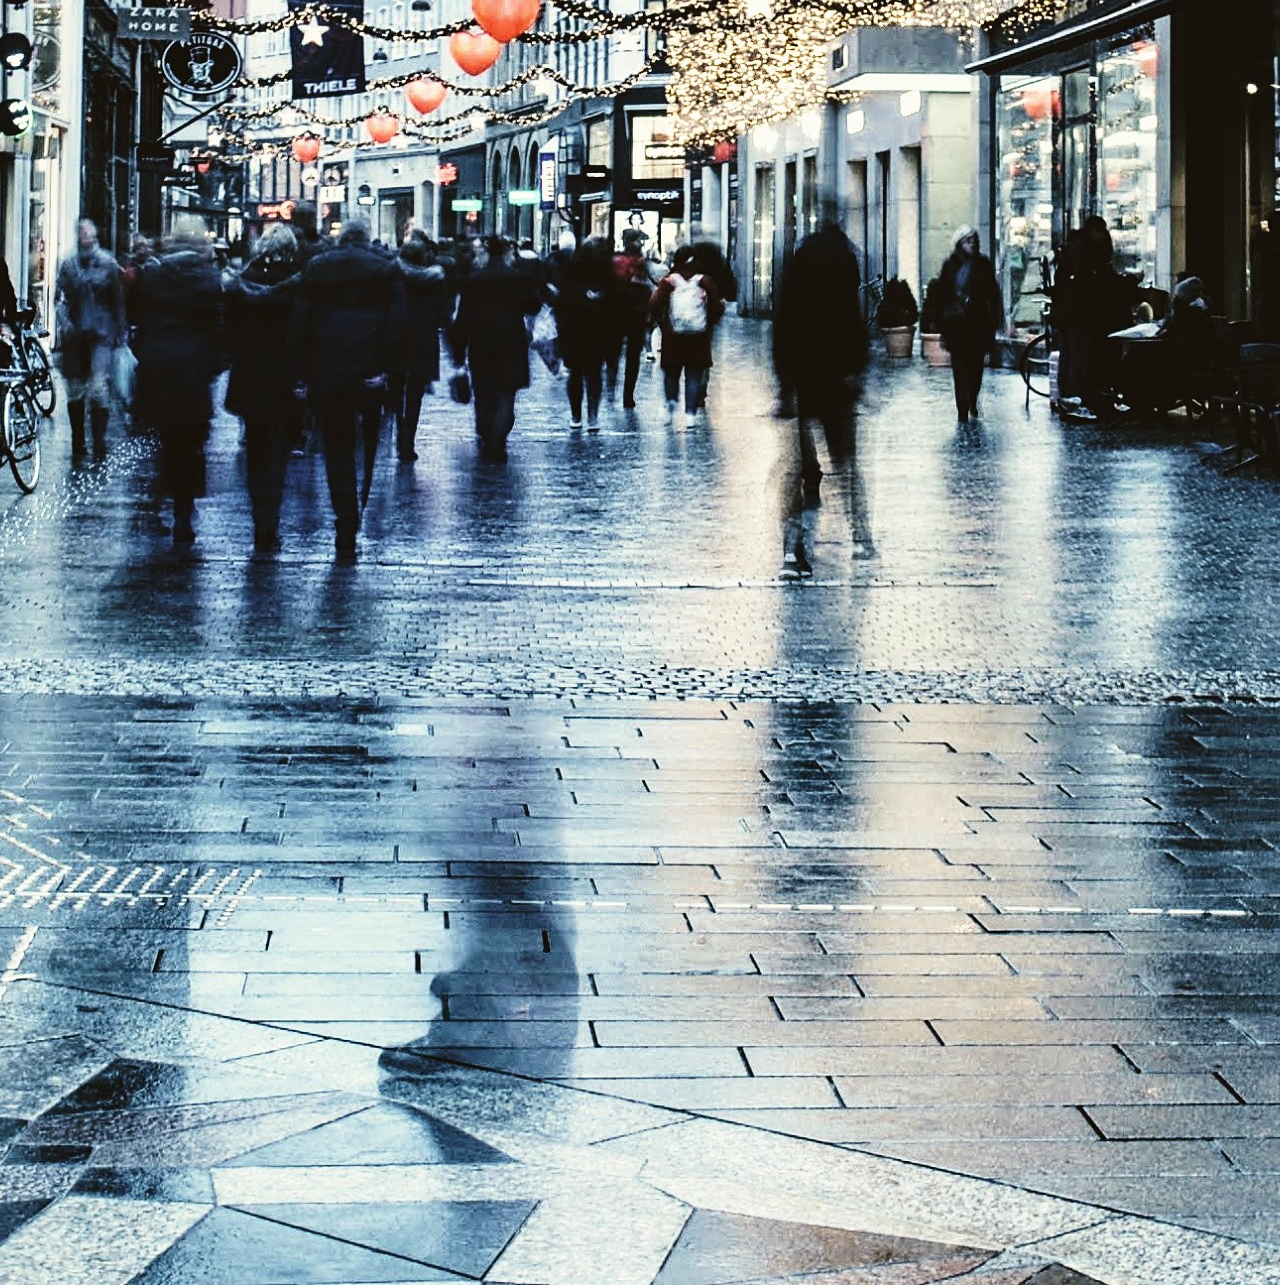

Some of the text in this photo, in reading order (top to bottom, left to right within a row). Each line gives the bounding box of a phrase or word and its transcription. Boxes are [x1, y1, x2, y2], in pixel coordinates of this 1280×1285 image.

[129, 7, 179, 18] ZARA
[128, 21, 179, 33] HOME
[304, 78, 357, 94] THIELE
